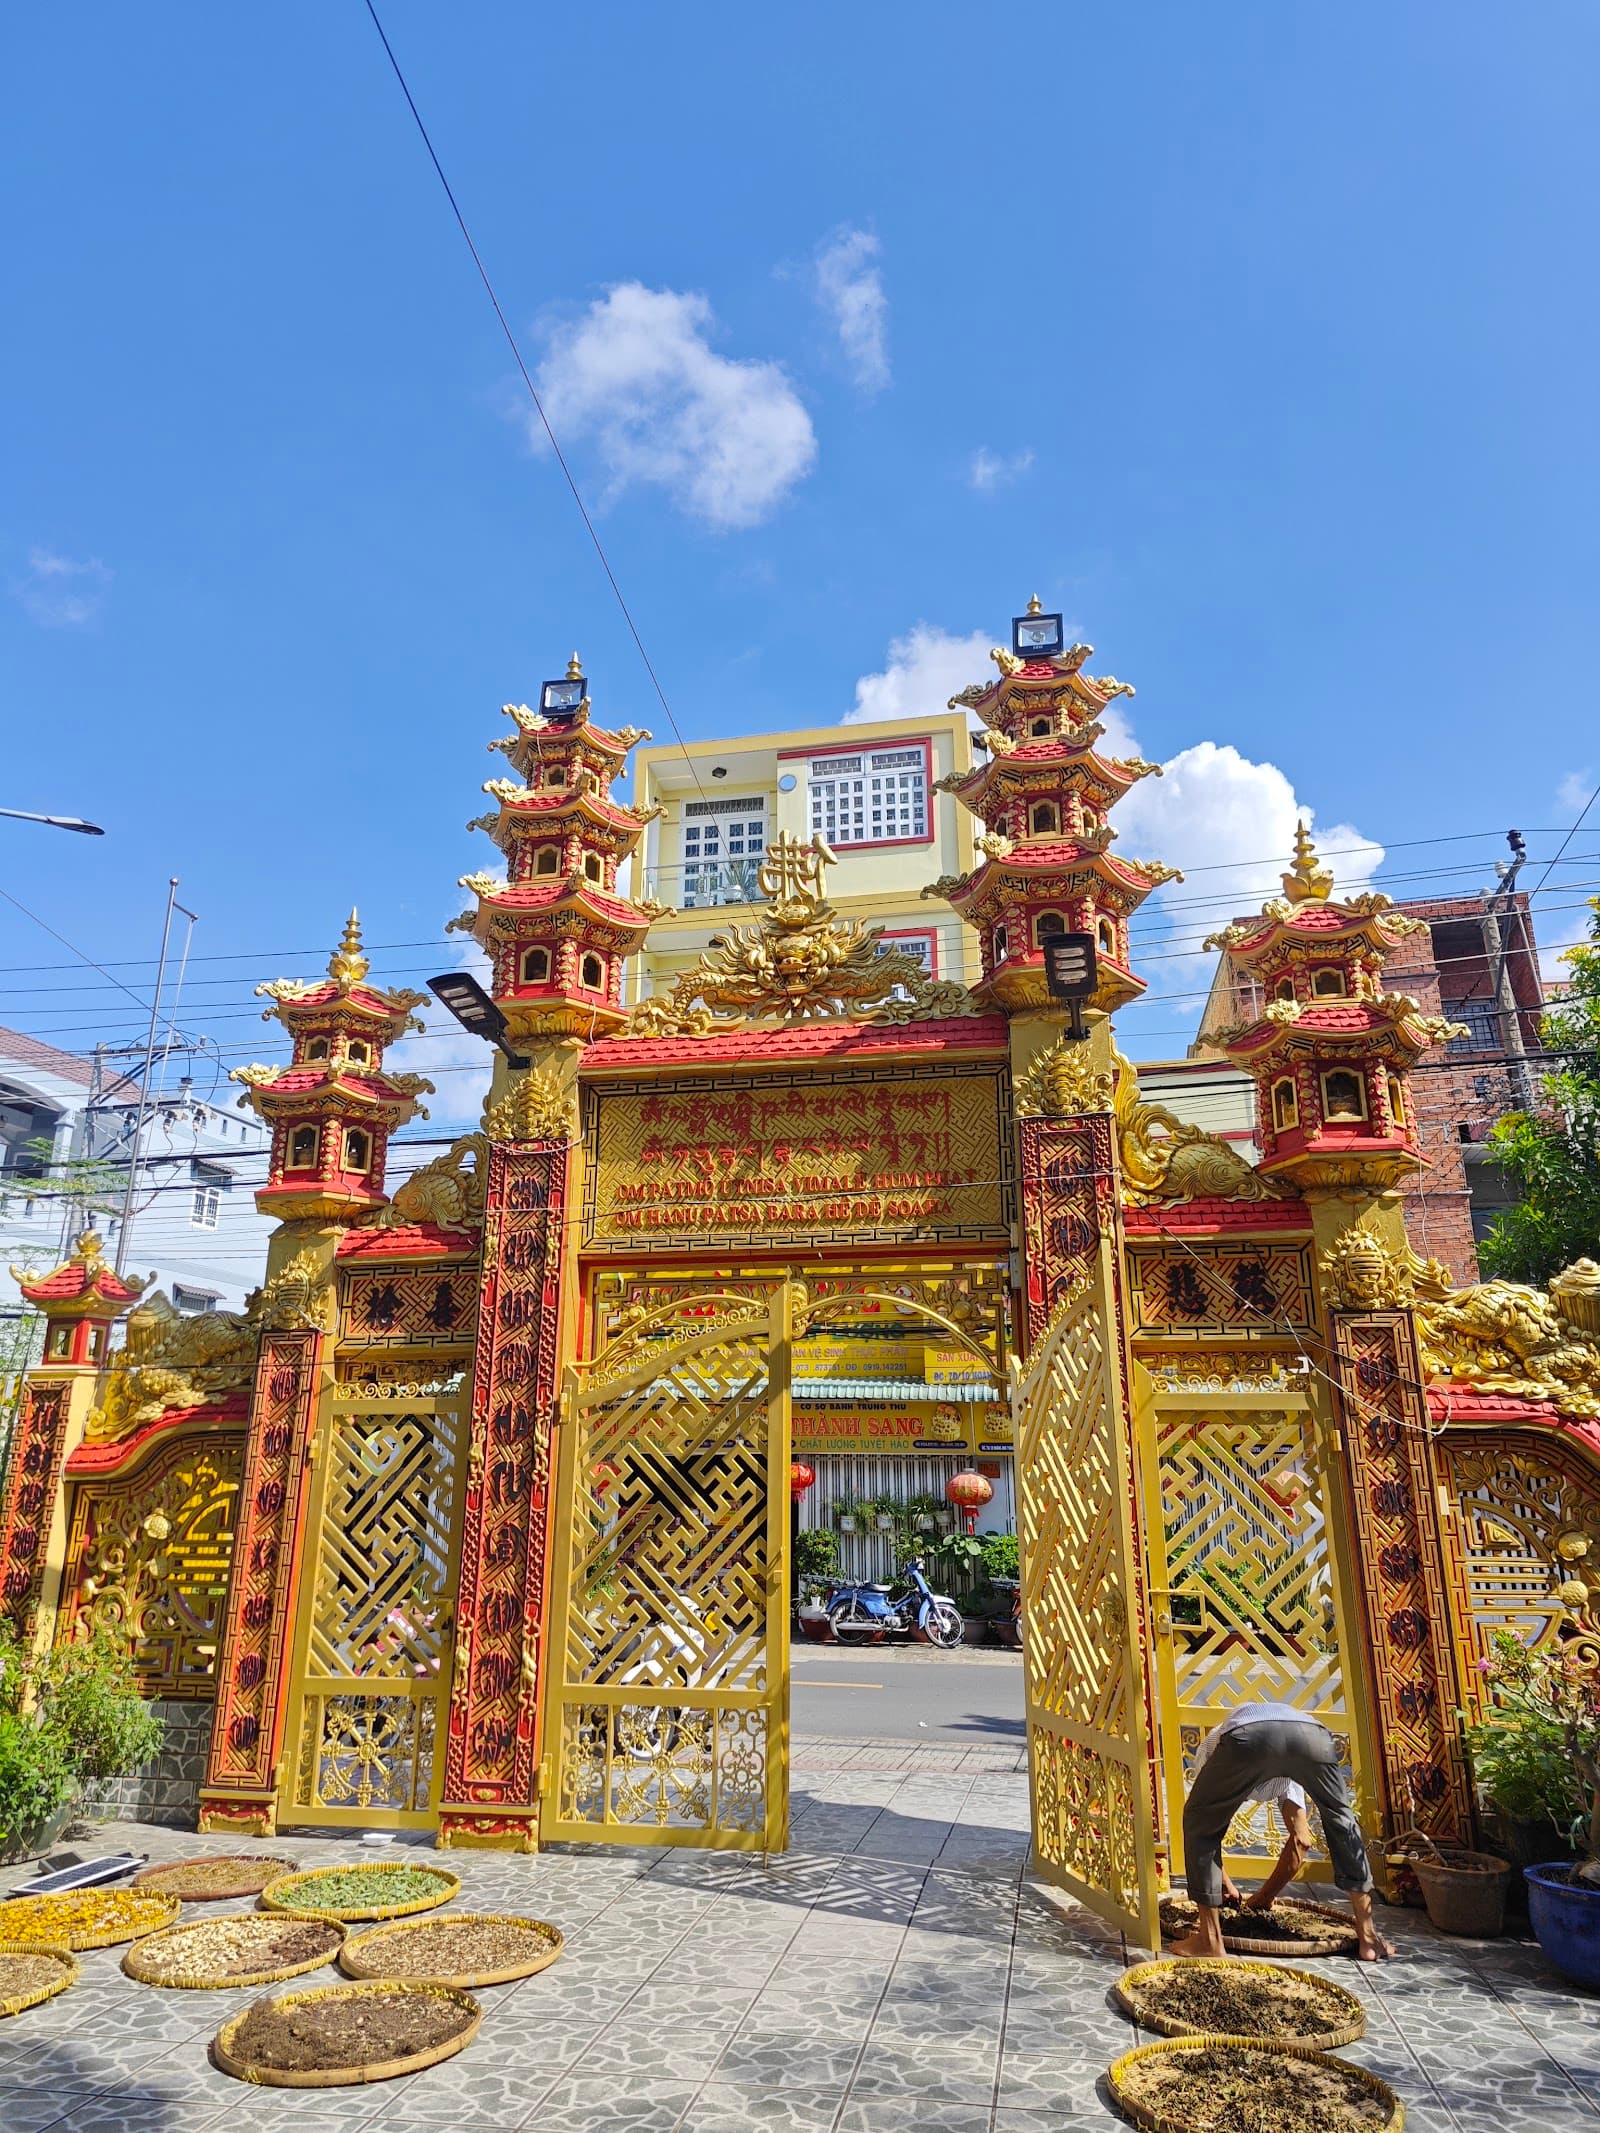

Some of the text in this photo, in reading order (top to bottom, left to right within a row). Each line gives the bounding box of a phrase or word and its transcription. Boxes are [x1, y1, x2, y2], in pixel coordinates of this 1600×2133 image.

[617, 1183, 646, 1200] OM
[793, 1167, 867, 1193] VIMALÊ
[873, 1171, 921, 1189] HUM
[924, 1168, 977, 1187] PHAT
[615, 1210, 643, 1227] OM
[647, 1207, 698, 1226] HANU
[703, 1204, 765, 1223] PATSA
[767, 1203, 821, 1221] BARA
[824, 1195, 852, 1219] HÊ
[887, 1198, 953, 1217] SOAHA
[824, 1346, 848, 1358] SINH
[857, 1402, 887, 1411] TRUNG
[889, 1402, 907, 1411] THU
[791, 1411, 924, 1437] THÀNH SANG
[826, 1437, 857, 1450] LƯỢNG
